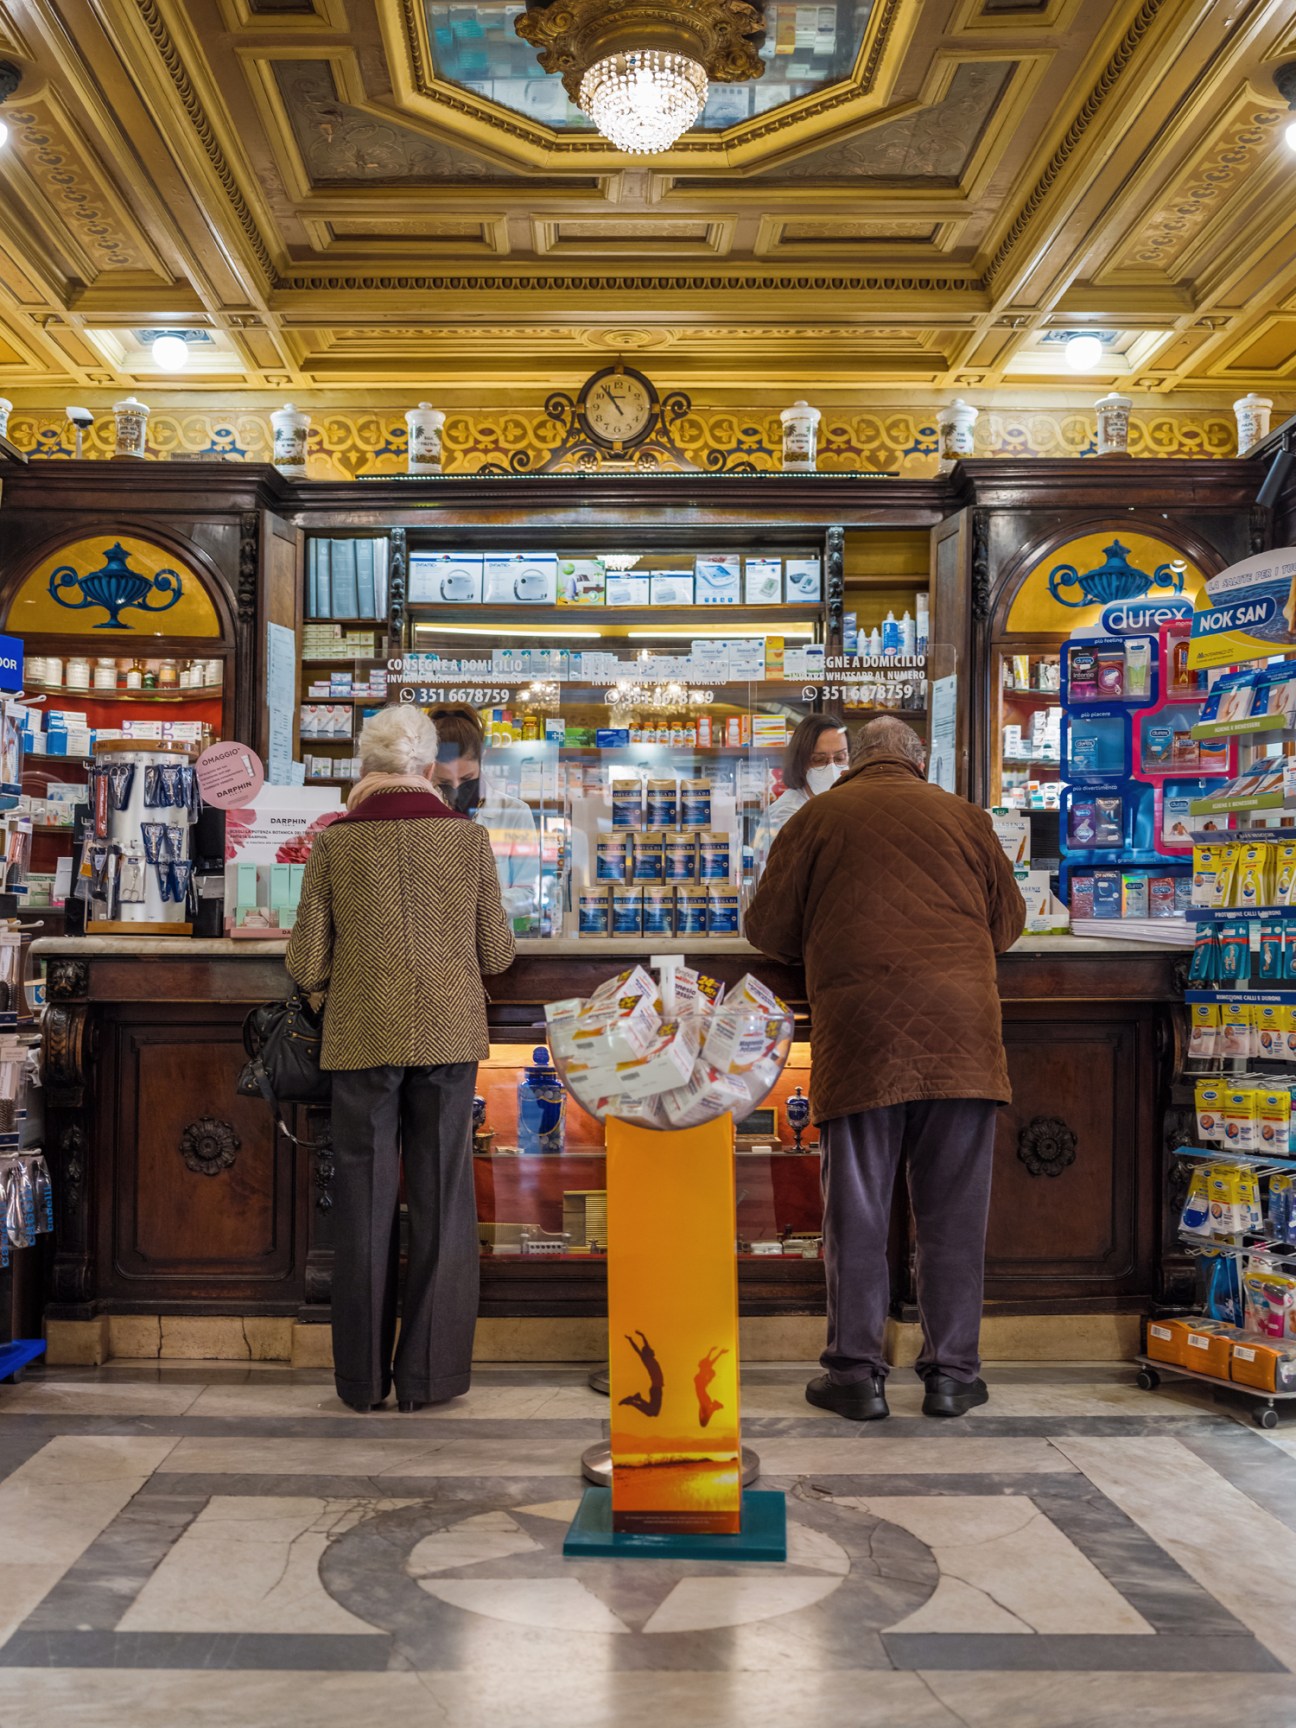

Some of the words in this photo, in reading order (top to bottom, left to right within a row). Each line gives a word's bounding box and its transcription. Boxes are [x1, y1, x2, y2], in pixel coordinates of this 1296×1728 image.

[1109, 606, 1187, 629] durex
[1200, 610, 1234, 632] NOK
[1235, 603, 1267, 625] SAN
[387, 659, 448, 671] CONSEGNE
[451, 660, 458, 670] A
[462, 660, 523, 671] DOMICILIO
[852, 656, 860, 667] A
[863, 655, 925, 667] DOMICILIO
[875, 671, 885, 680] AL
[888, 670, 925, 679] NUMERO
[420, 688, 445, 702] 351
[448, 688, 510, 702] 6678759
[822, 686, 846, 700] 351
[851, 685, 913, 700] 6678759
[216, 781, 252, 798] DARPHIN
